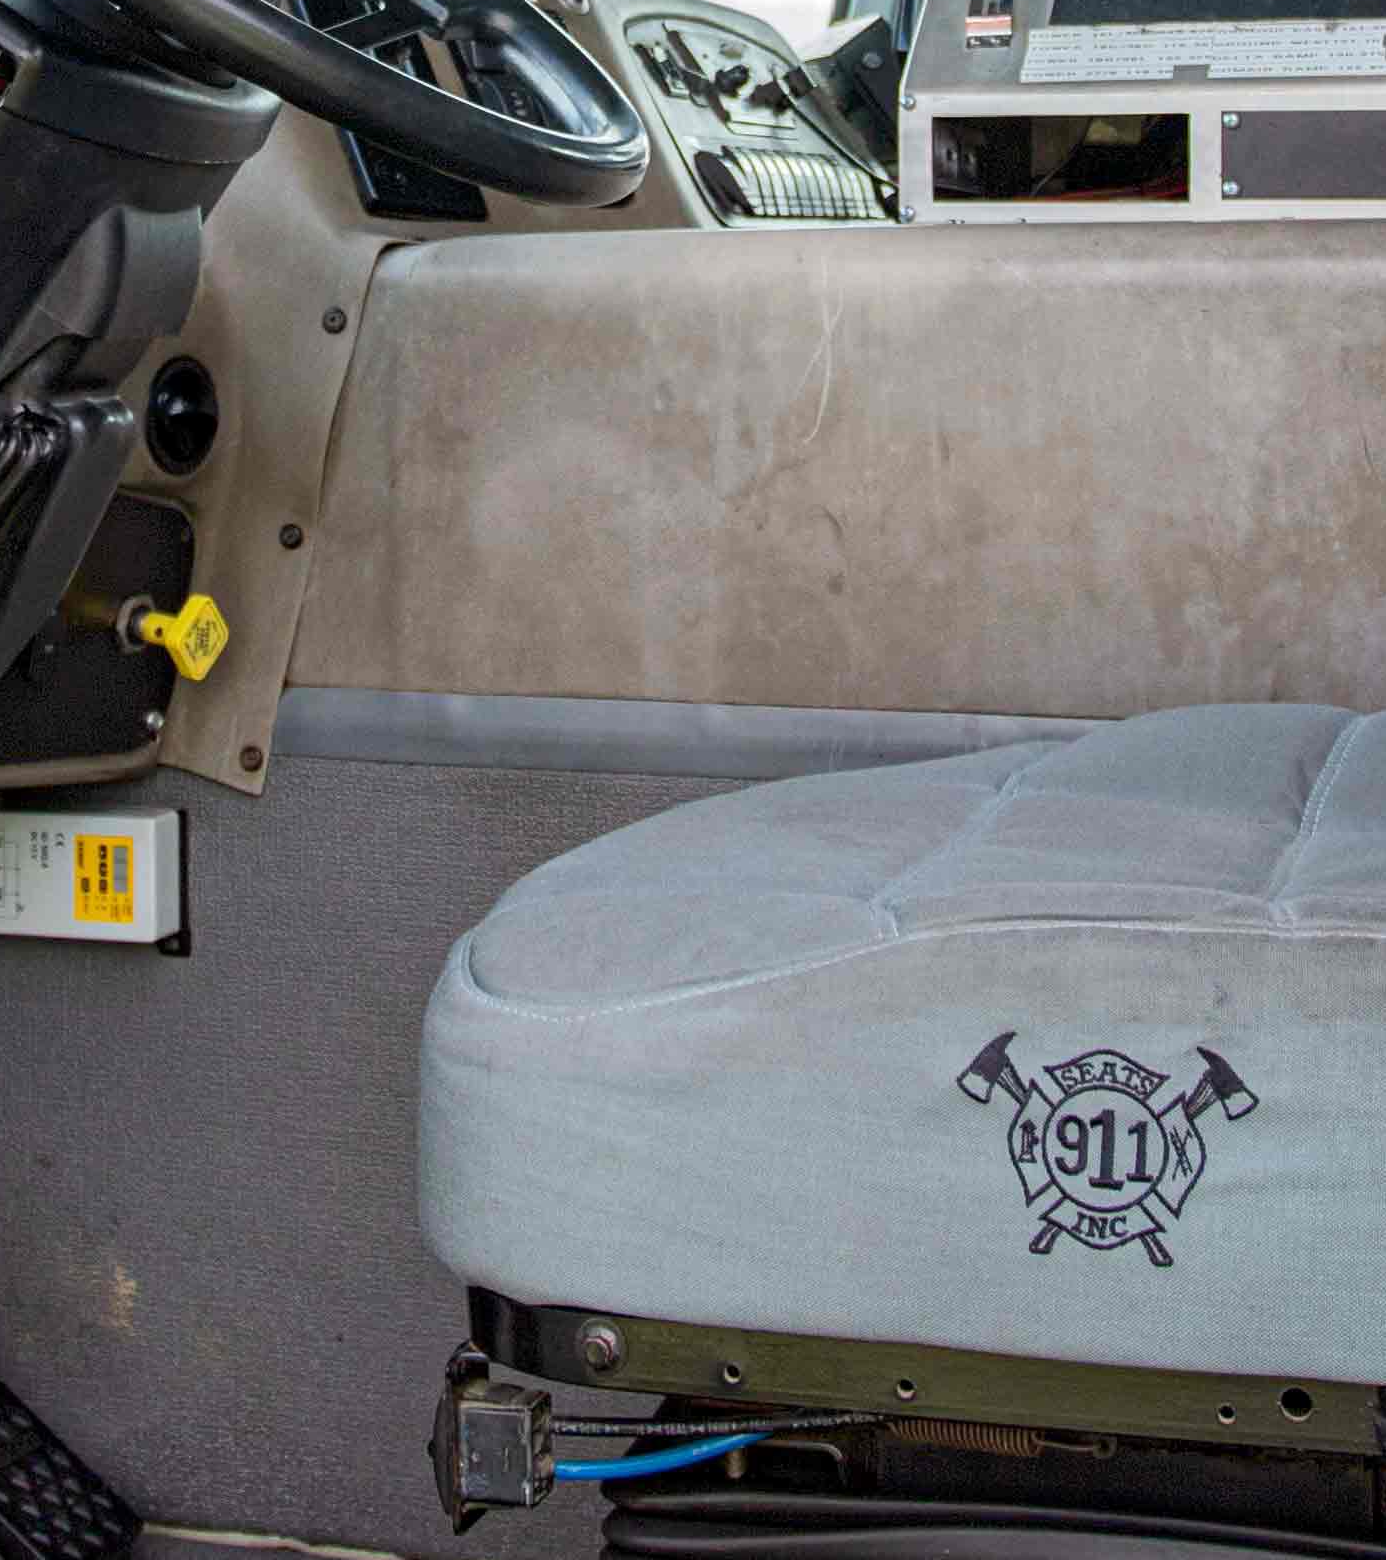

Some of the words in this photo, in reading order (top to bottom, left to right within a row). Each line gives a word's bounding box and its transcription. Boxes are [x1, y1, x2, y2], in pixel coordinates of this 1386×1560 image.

[1060, 1060, 1156, 1095] SEATS
[1054, 1108, 1154, 1191] 911
[1071, 1211, 1128, 1239] INC
